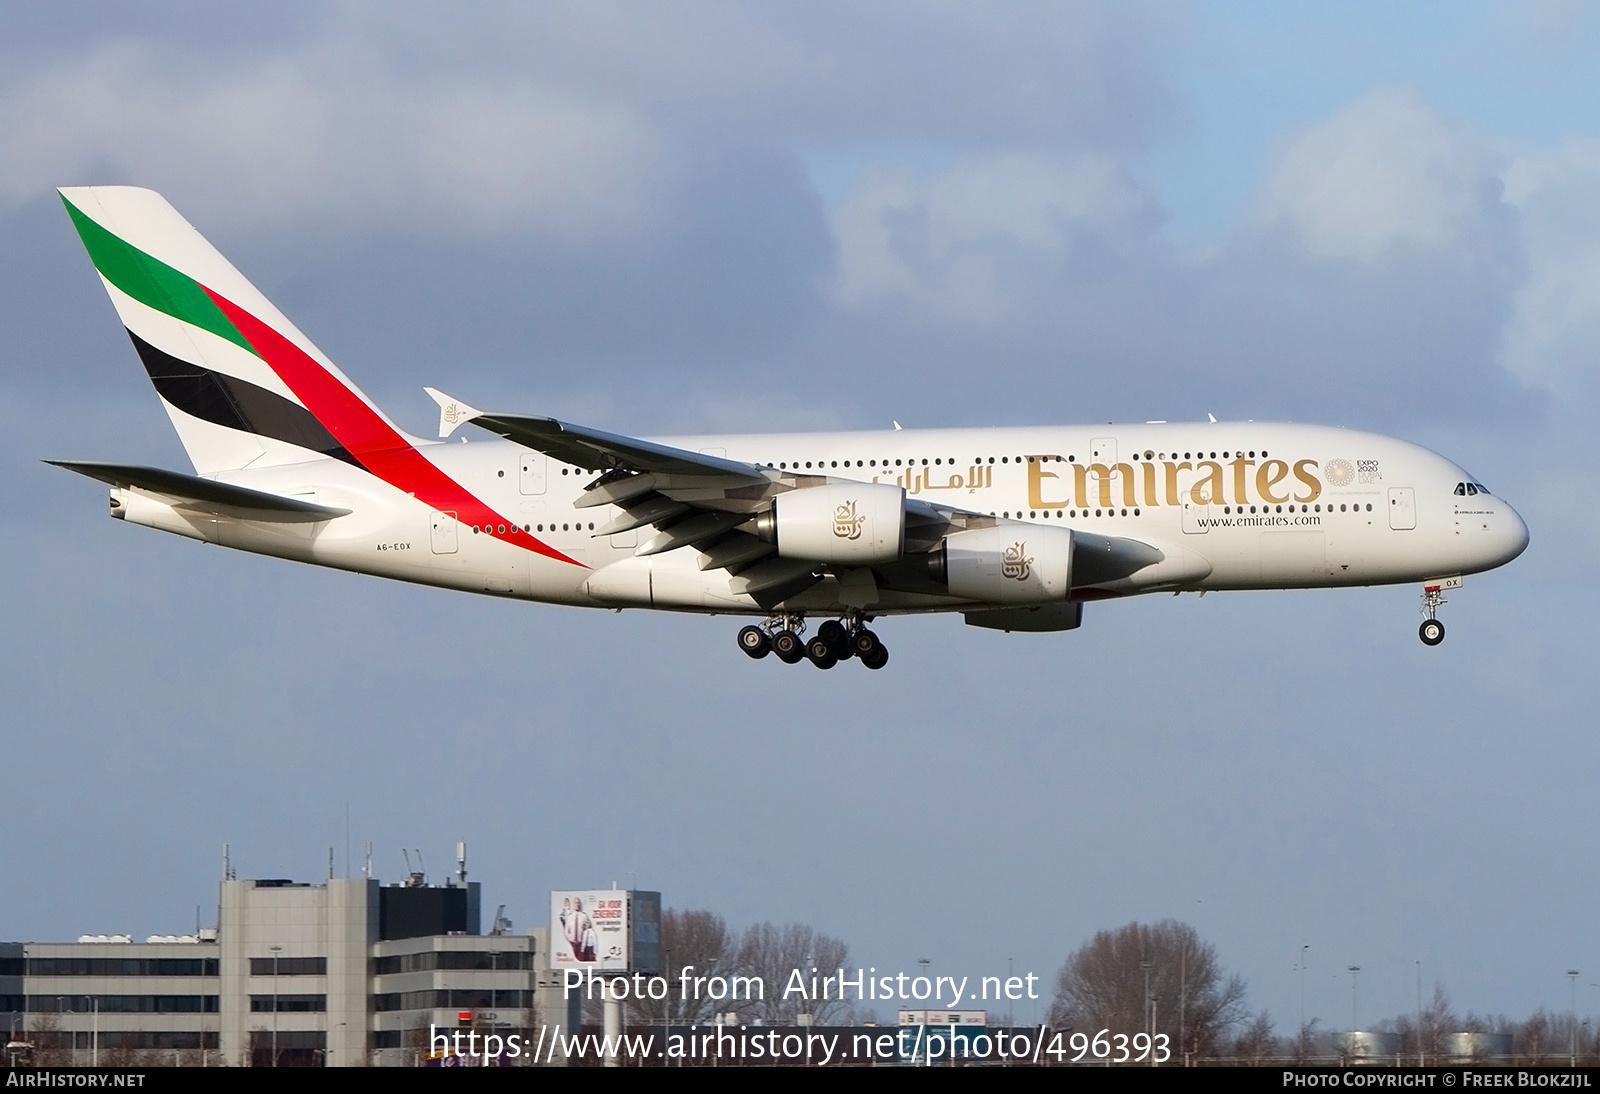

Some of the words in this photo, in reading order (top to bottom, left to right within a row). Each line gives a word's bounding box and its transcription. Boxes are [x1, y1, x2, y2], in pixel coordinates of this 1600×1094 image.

[1024, 450, 1321, 510] Emirates
[1197, 514, 1321, 528] www.emirates.com
[376, 543, 411, 552] A6-EOX
[1446, 579, 1458, 587] OX
